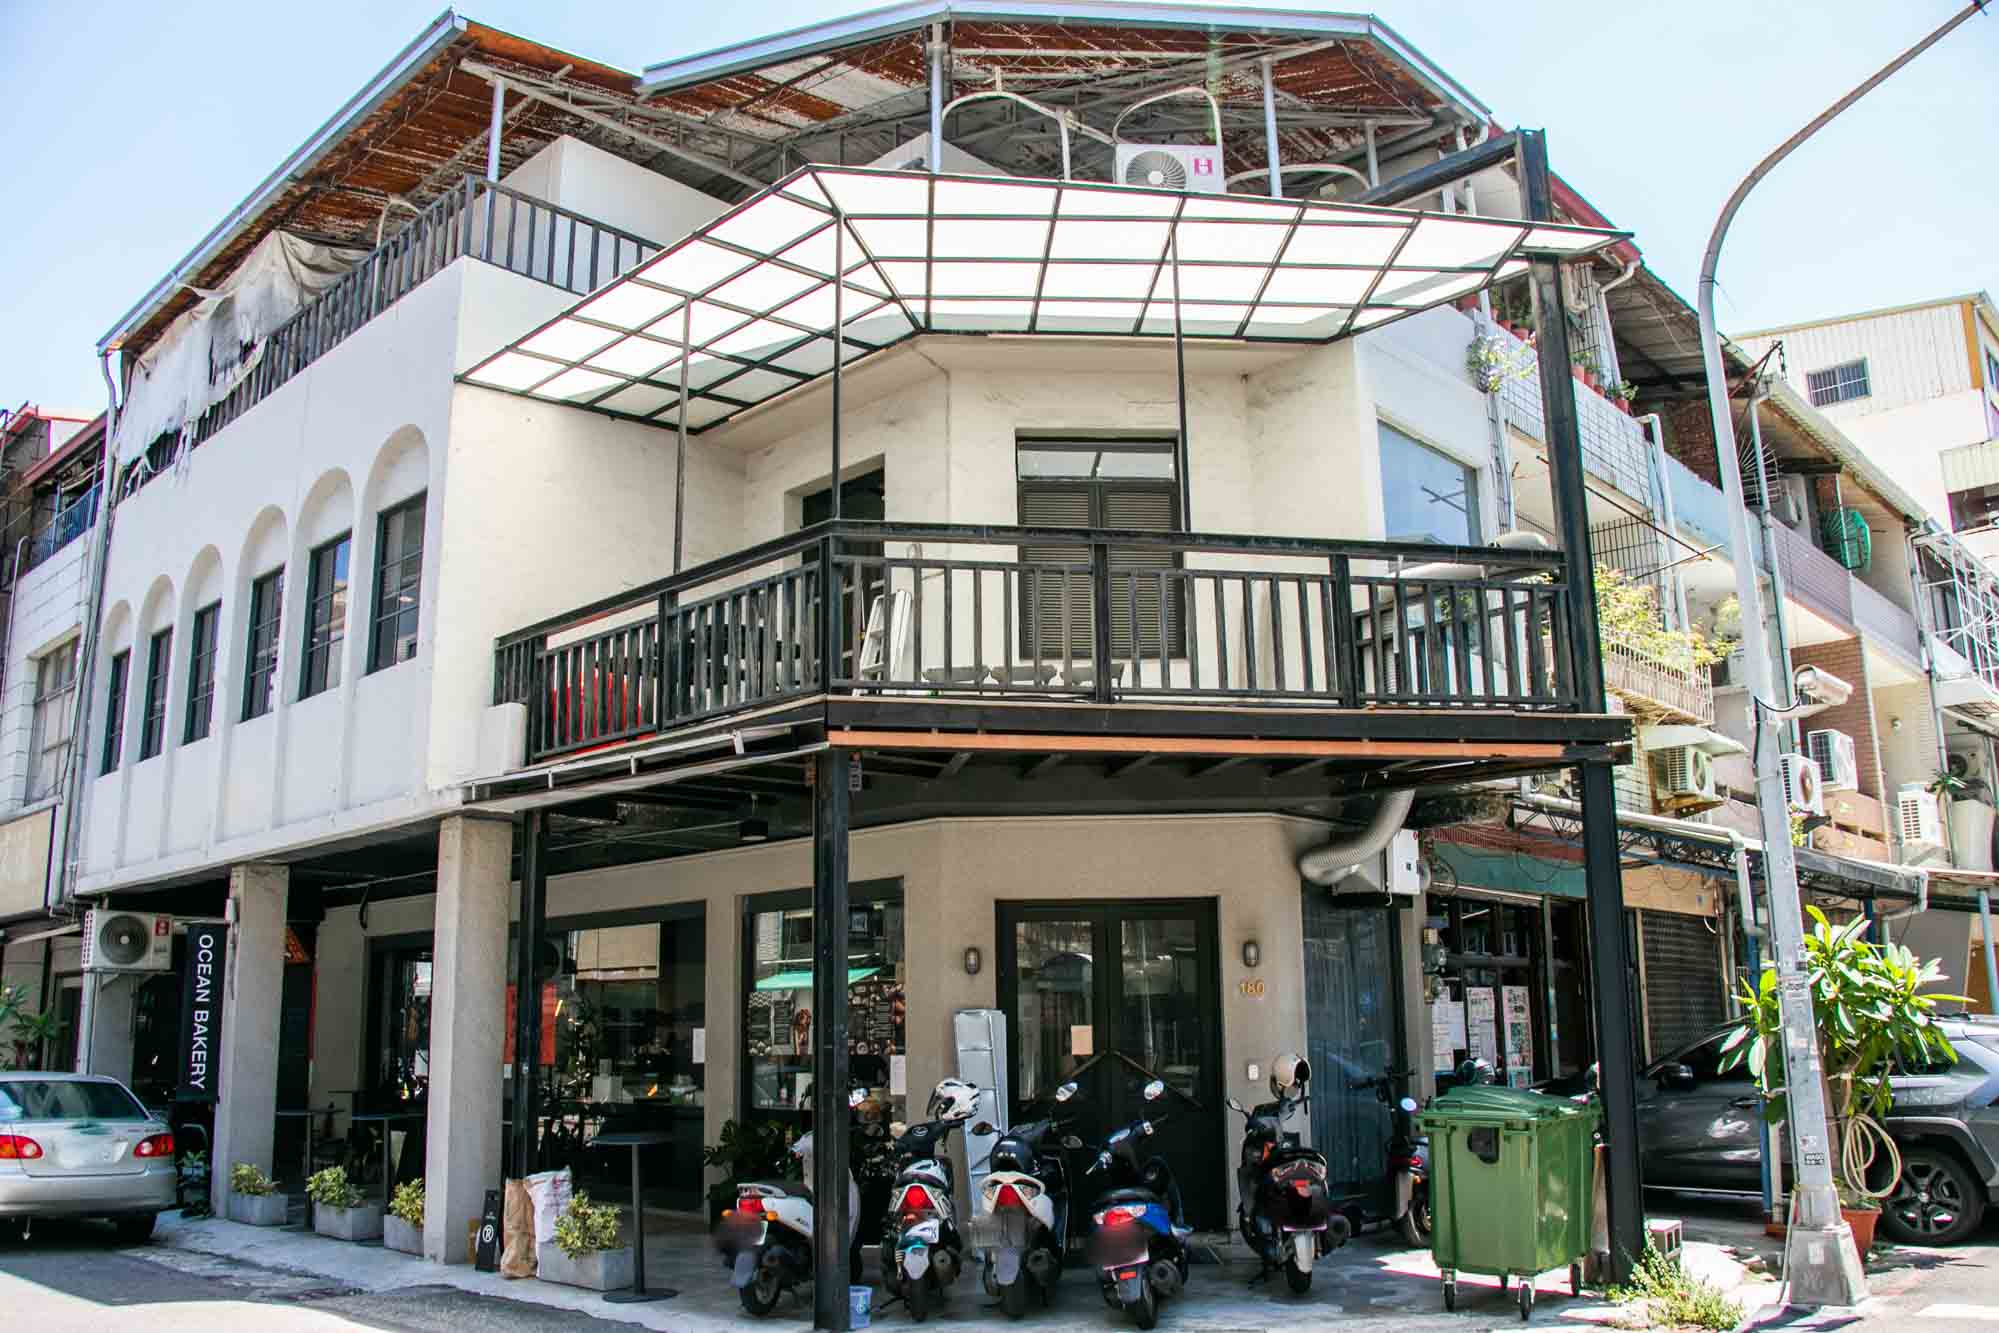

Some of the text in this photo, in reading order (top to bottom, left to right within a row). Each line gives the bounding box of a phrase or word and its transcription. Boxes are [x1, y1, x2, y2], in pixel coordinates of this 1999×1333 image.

[190, 933, 215, 1090] OCEAN BAKERY
[1239, 980, 1265, 995] 180
